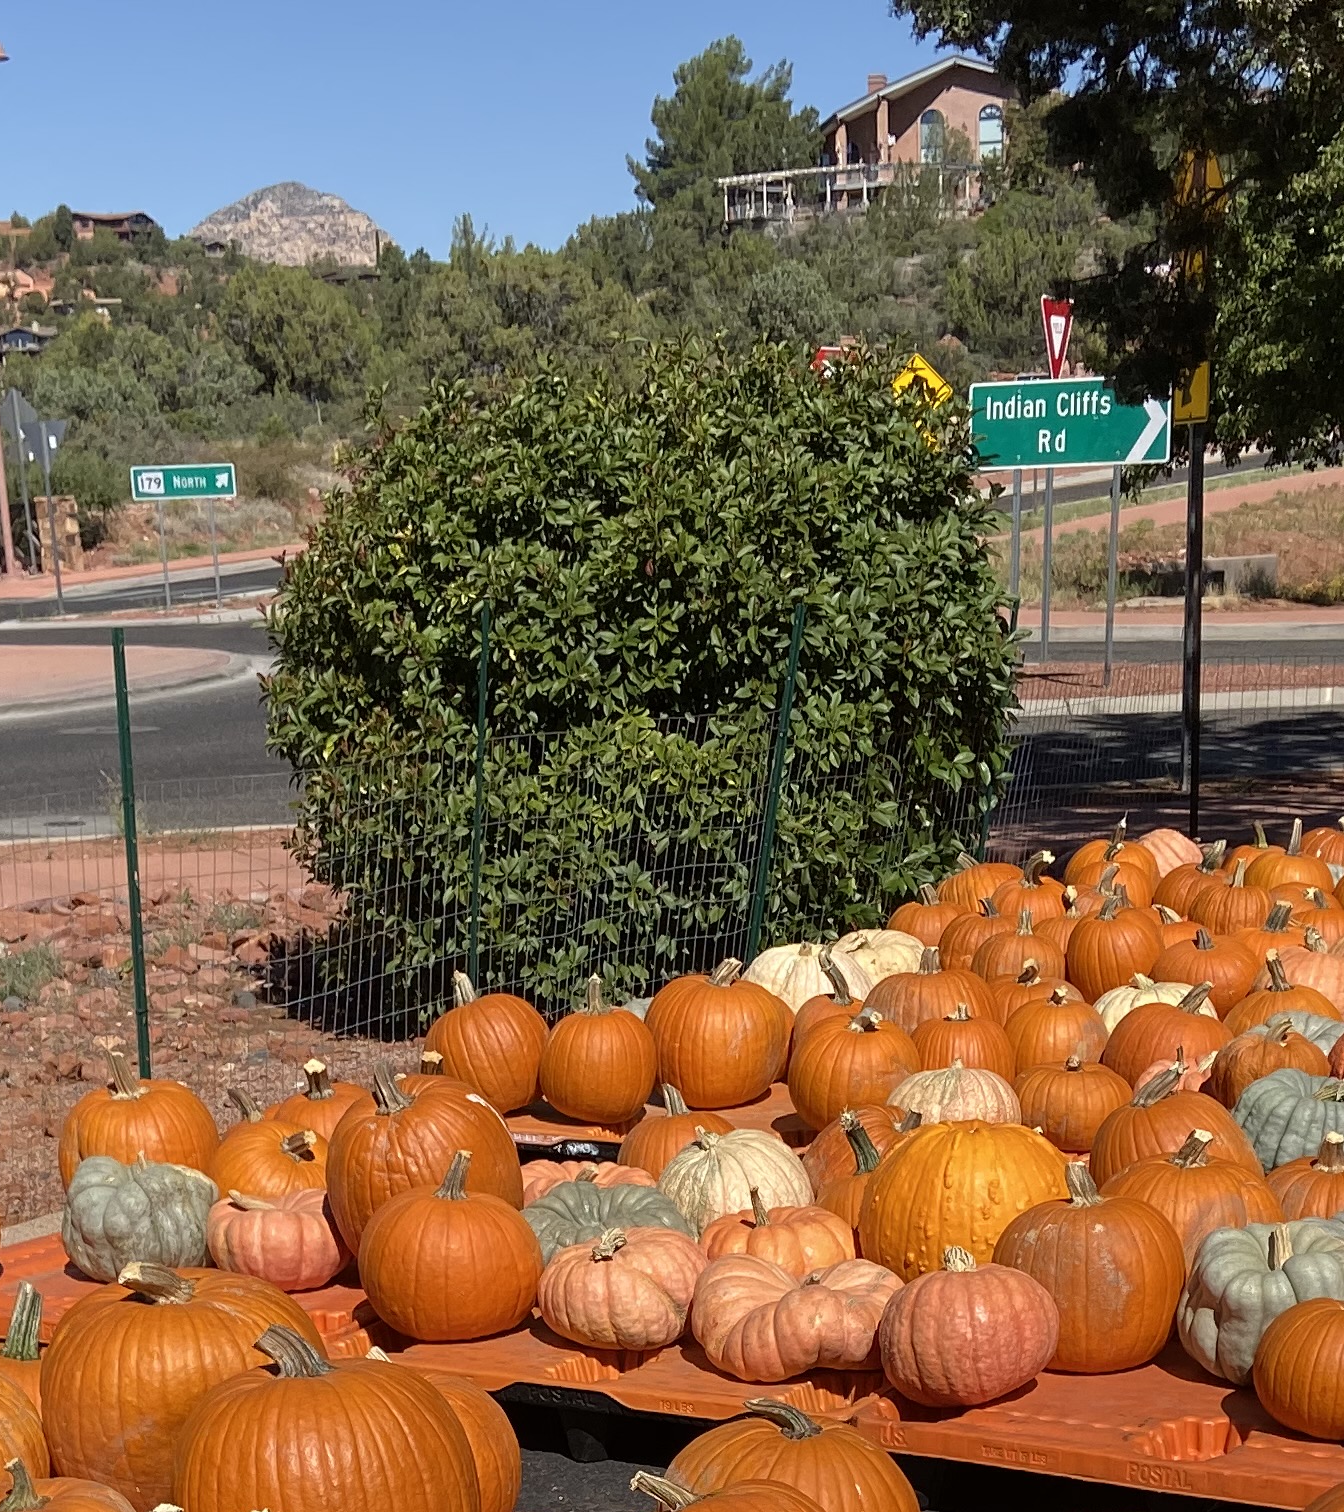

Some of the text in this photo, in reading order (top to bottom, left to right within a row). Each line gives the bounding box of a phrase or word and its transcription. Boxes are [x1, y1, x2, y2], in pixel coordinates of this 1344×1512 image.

[985, 391, 1112, 421] Indian Cliffs
[1037, 429, 1066, 453] Rd
[140, 477, 162, 490] 179
[1125, 1461, 1193, 1490] POSTAL
